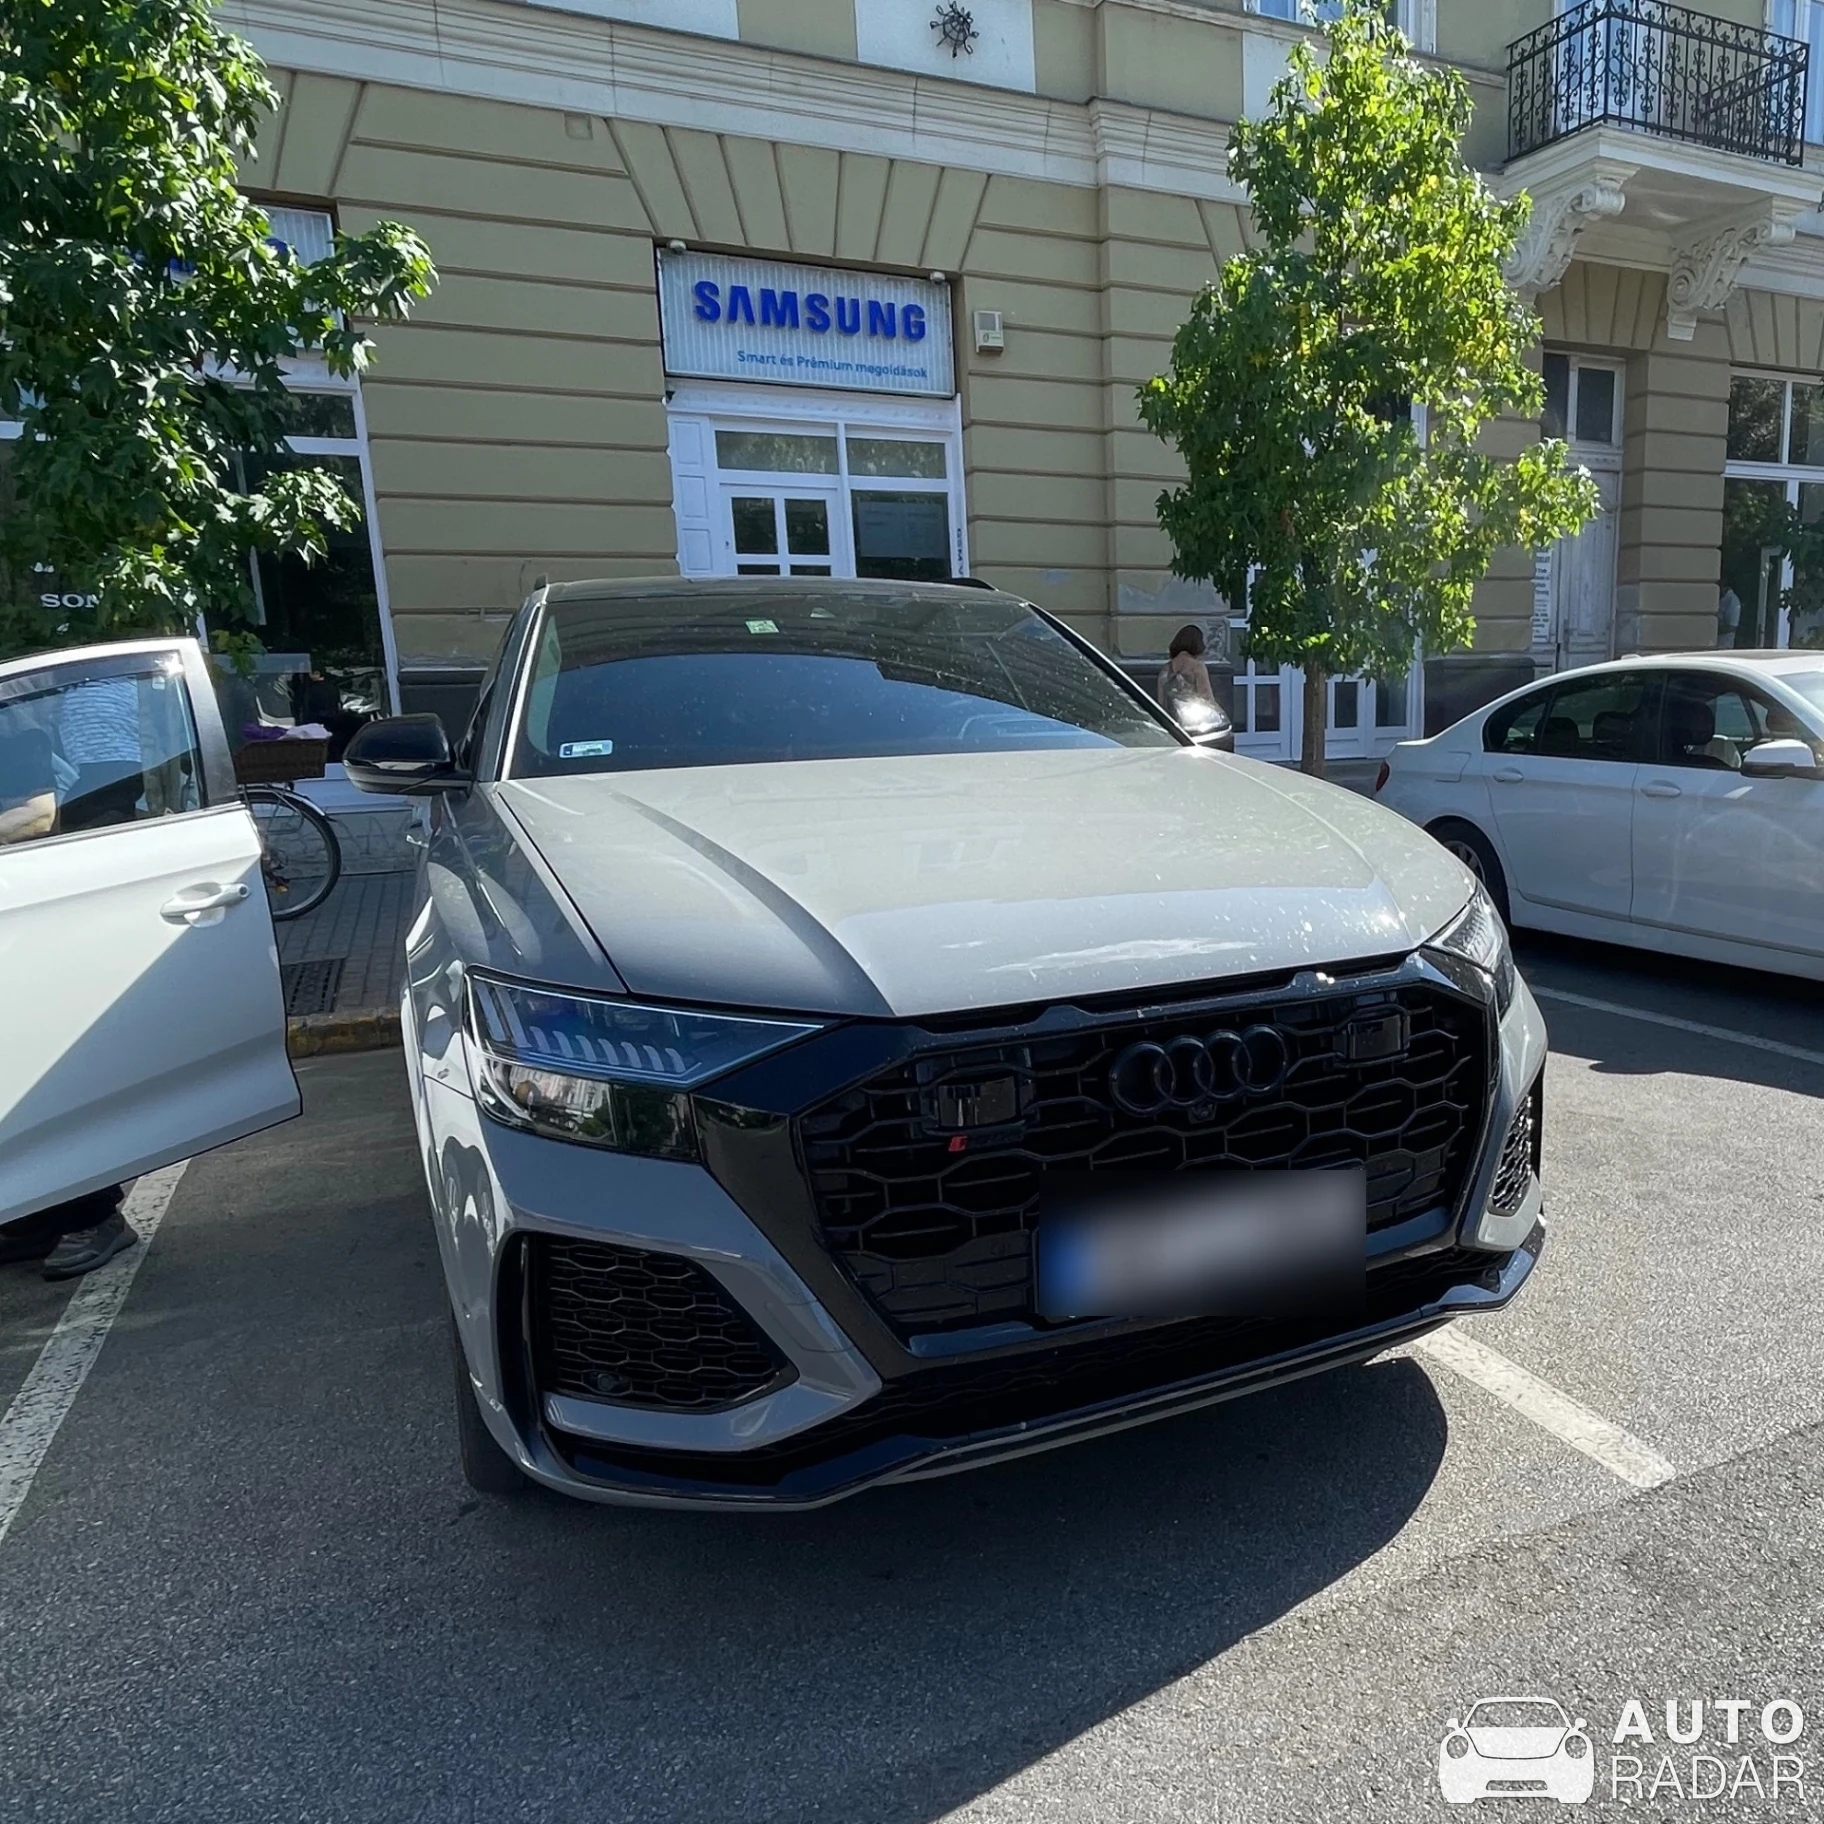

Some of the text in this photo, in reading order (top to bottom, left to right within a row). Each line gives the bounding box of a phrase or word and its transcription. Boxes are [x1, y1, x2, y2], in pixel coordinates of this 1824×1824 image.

[693, 280, 927, 342] SAMSUNG
[737, 350, 777, 365] Smart
[779, 353, 794, 367] és
[855, 363, 928, 378] megoldások
[40, 593, 100, 608] SON
